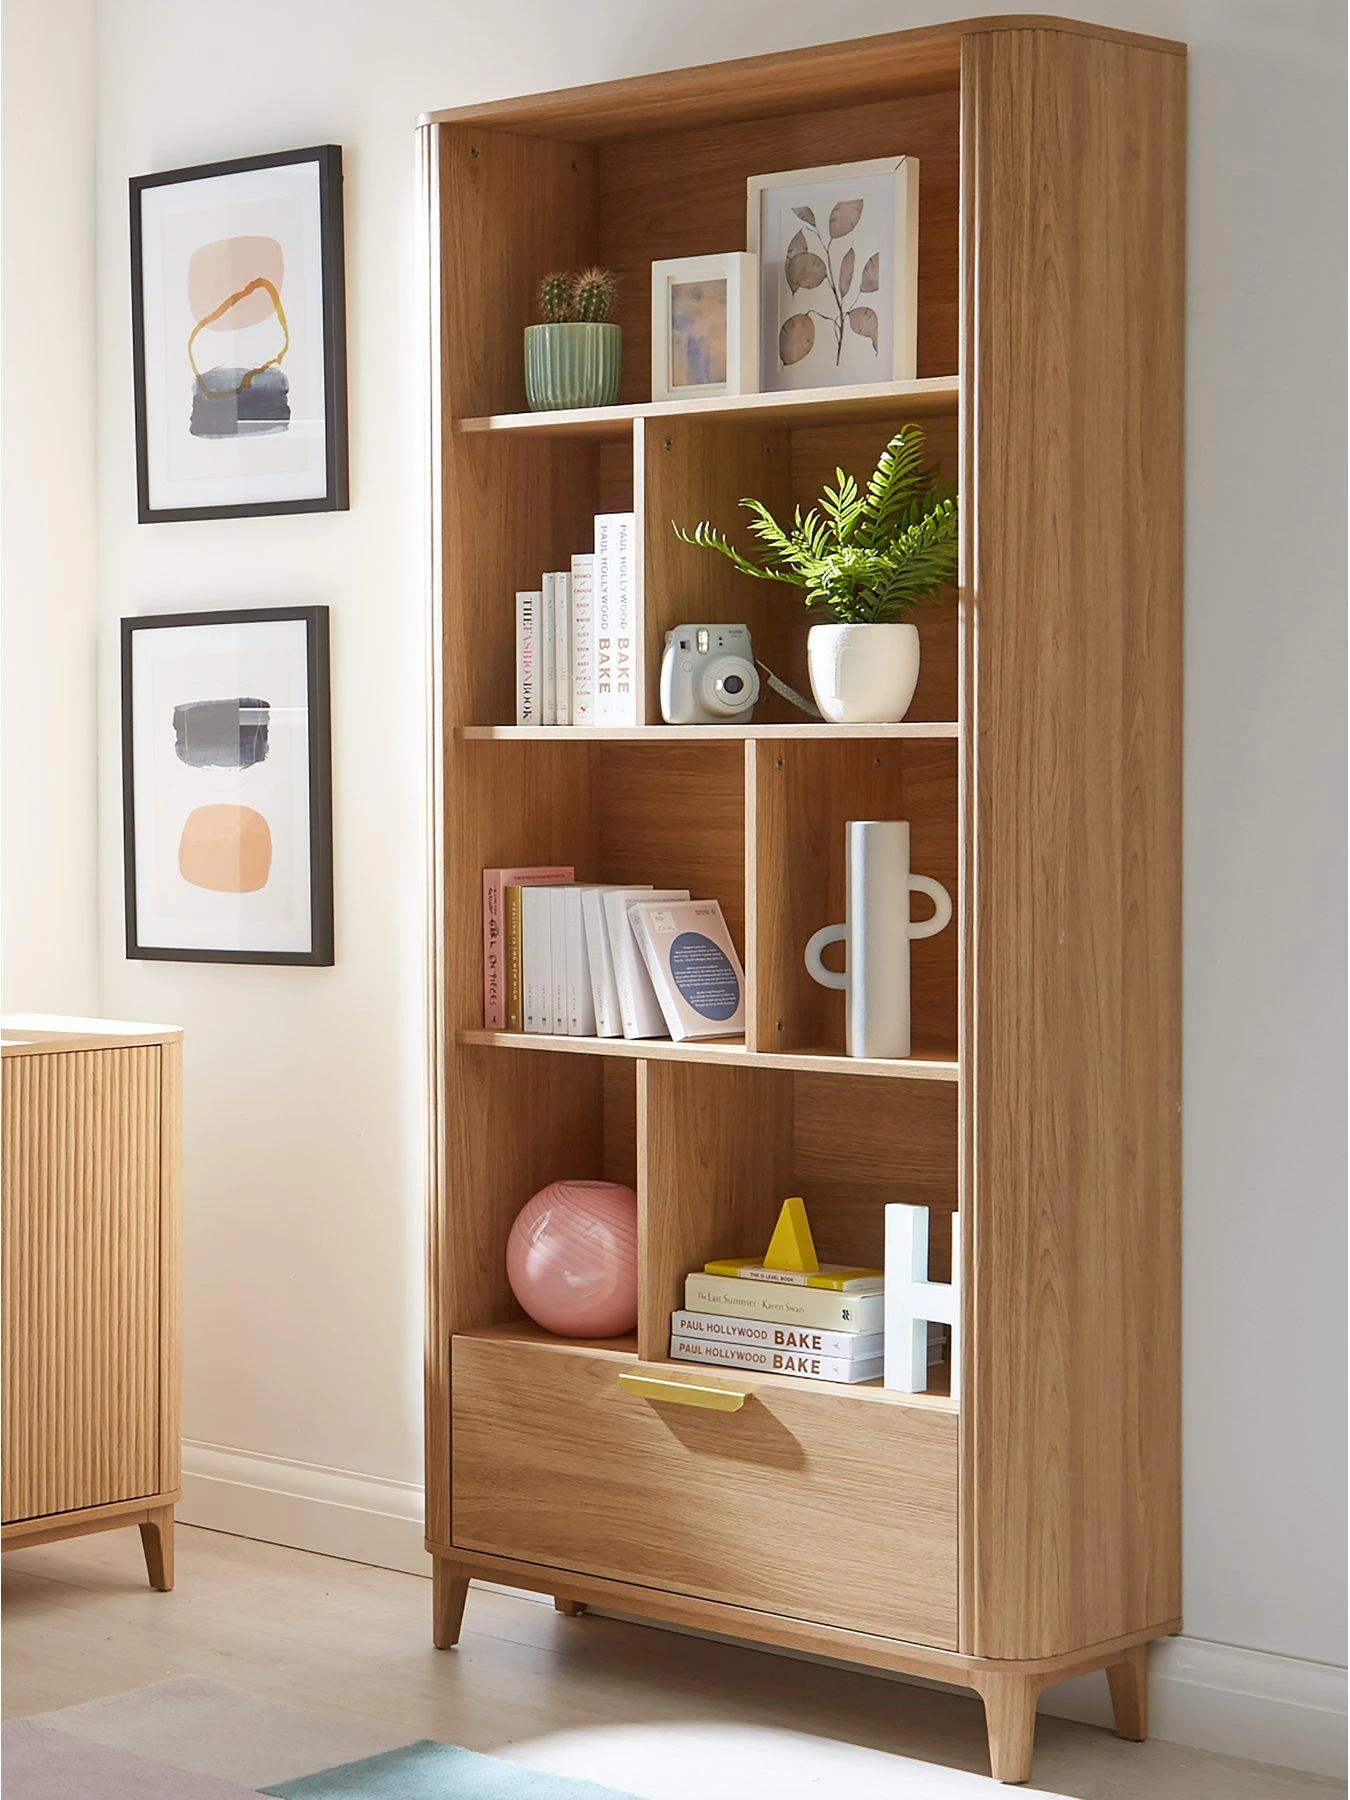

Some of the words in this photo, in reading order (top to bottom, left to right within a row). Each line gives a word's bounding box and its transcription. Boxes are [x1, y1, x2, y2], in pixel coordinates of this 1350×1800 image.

[600, 525, 609, 554] PAUL
[619, 524, 628, 554] PAUL
[600, 557, 609, 630] HOLLYWOOD
[619, 557, 628, 630] HOLLYWOOD
[599, 637, 611, 694] BAKE
[617, 637, 630, 694] BAKE
[707, 1292, 721, 1303] Last
[723, 1294, 756, 1308] Summer
[762, 1299, 784, 1311] Karen
[785, 1302, 805, 1313] Swan
[680, 1319, 704, 1331] PAUL
[706, 1324, 768, 1340] HOLLYWOOD
[774, 1330, 822, 1350] BAKE
[679, 1343, 703, 1355] PAUL
[705, 1347, 767, 1364] HOLLYWOOD
[772, 1355, 821, 1375] BAKE
